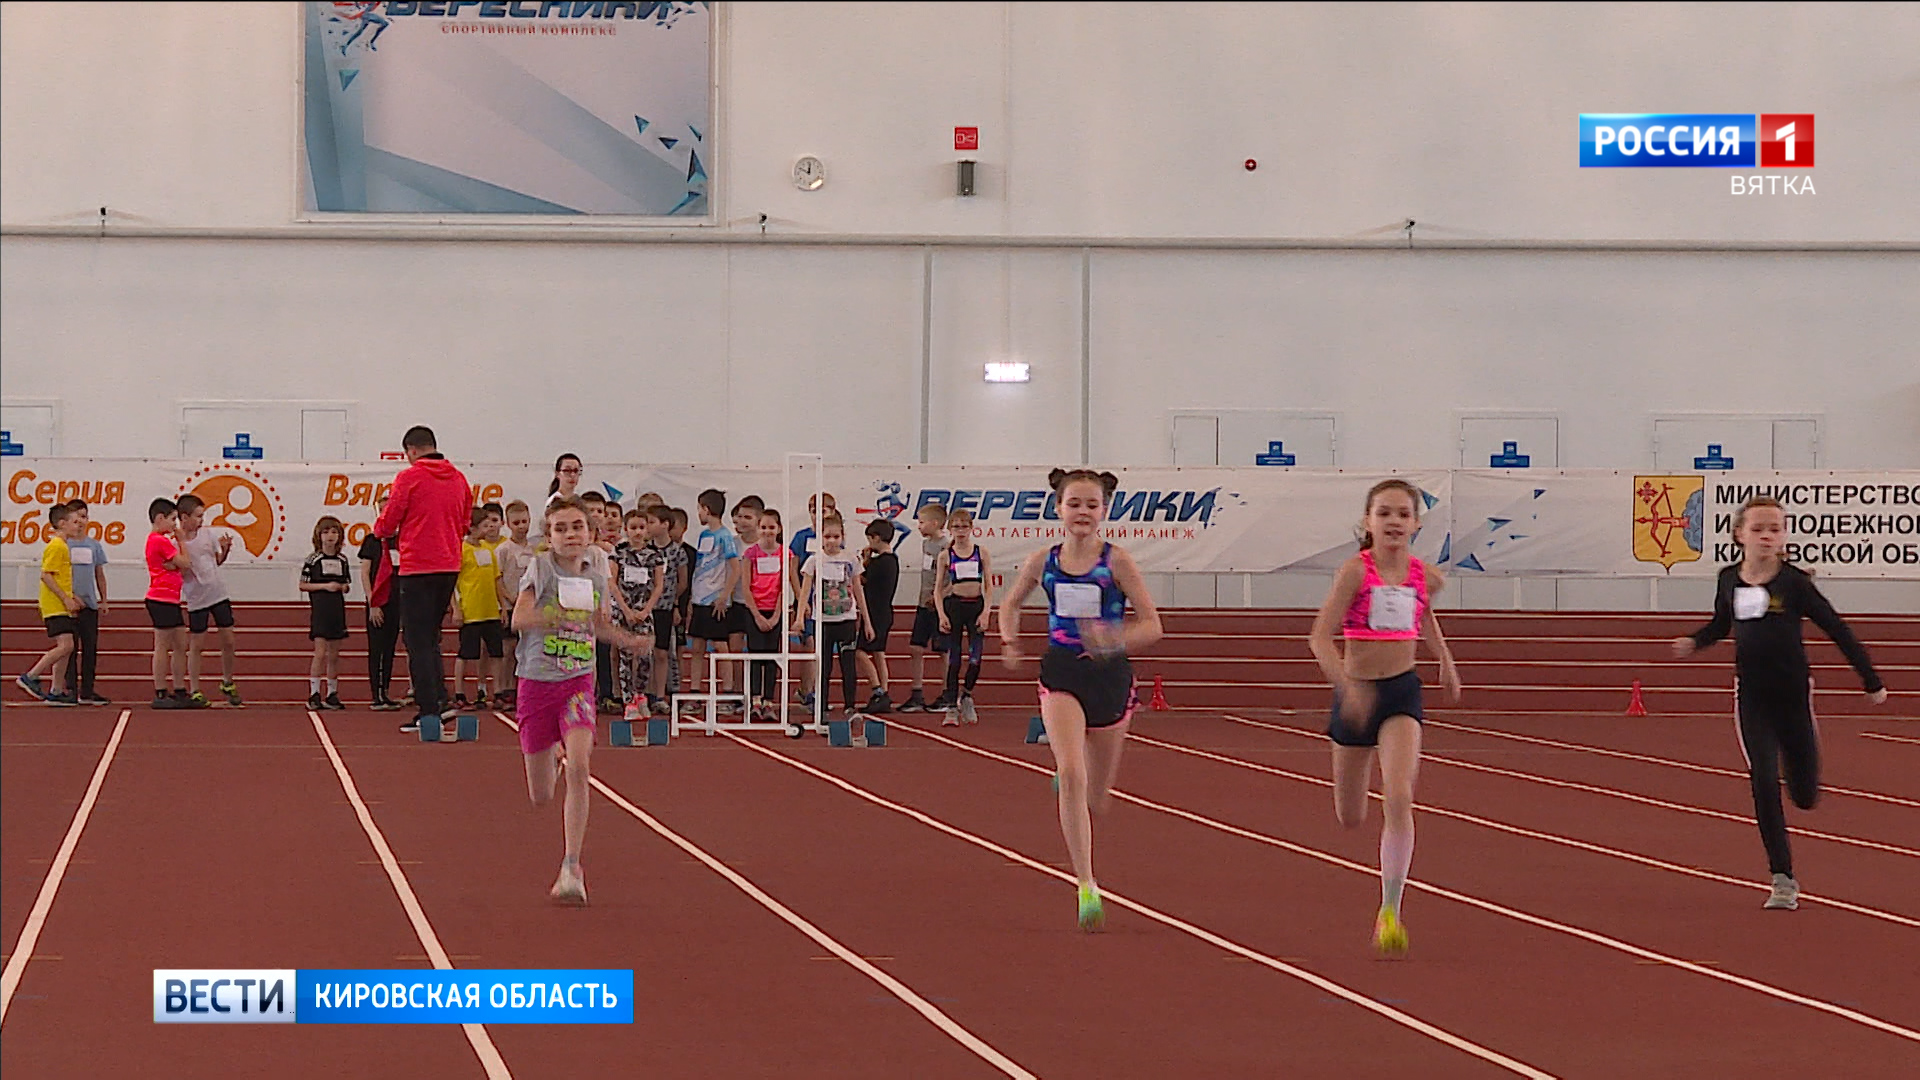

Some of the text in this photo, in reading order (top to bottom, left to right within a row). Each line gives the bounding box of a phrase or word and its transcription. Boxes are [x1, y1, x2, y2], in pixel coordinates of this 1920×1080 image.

[441, 23, 618, 37] СПОРТИВНЫЙ КОМПЛЕКС
[8, 469, 125, 505] Серия
[912, 489, 1217, 522] ВЕРЕИКИ
[1, 509, 126, 545] абеов
[1133, 527, 1196, 540] МАНЕЖ
[1715, 513, 1920, 538] И ЛОДЕЖНО
[1714, 538, 1873, 565] КИВСКОЙ
